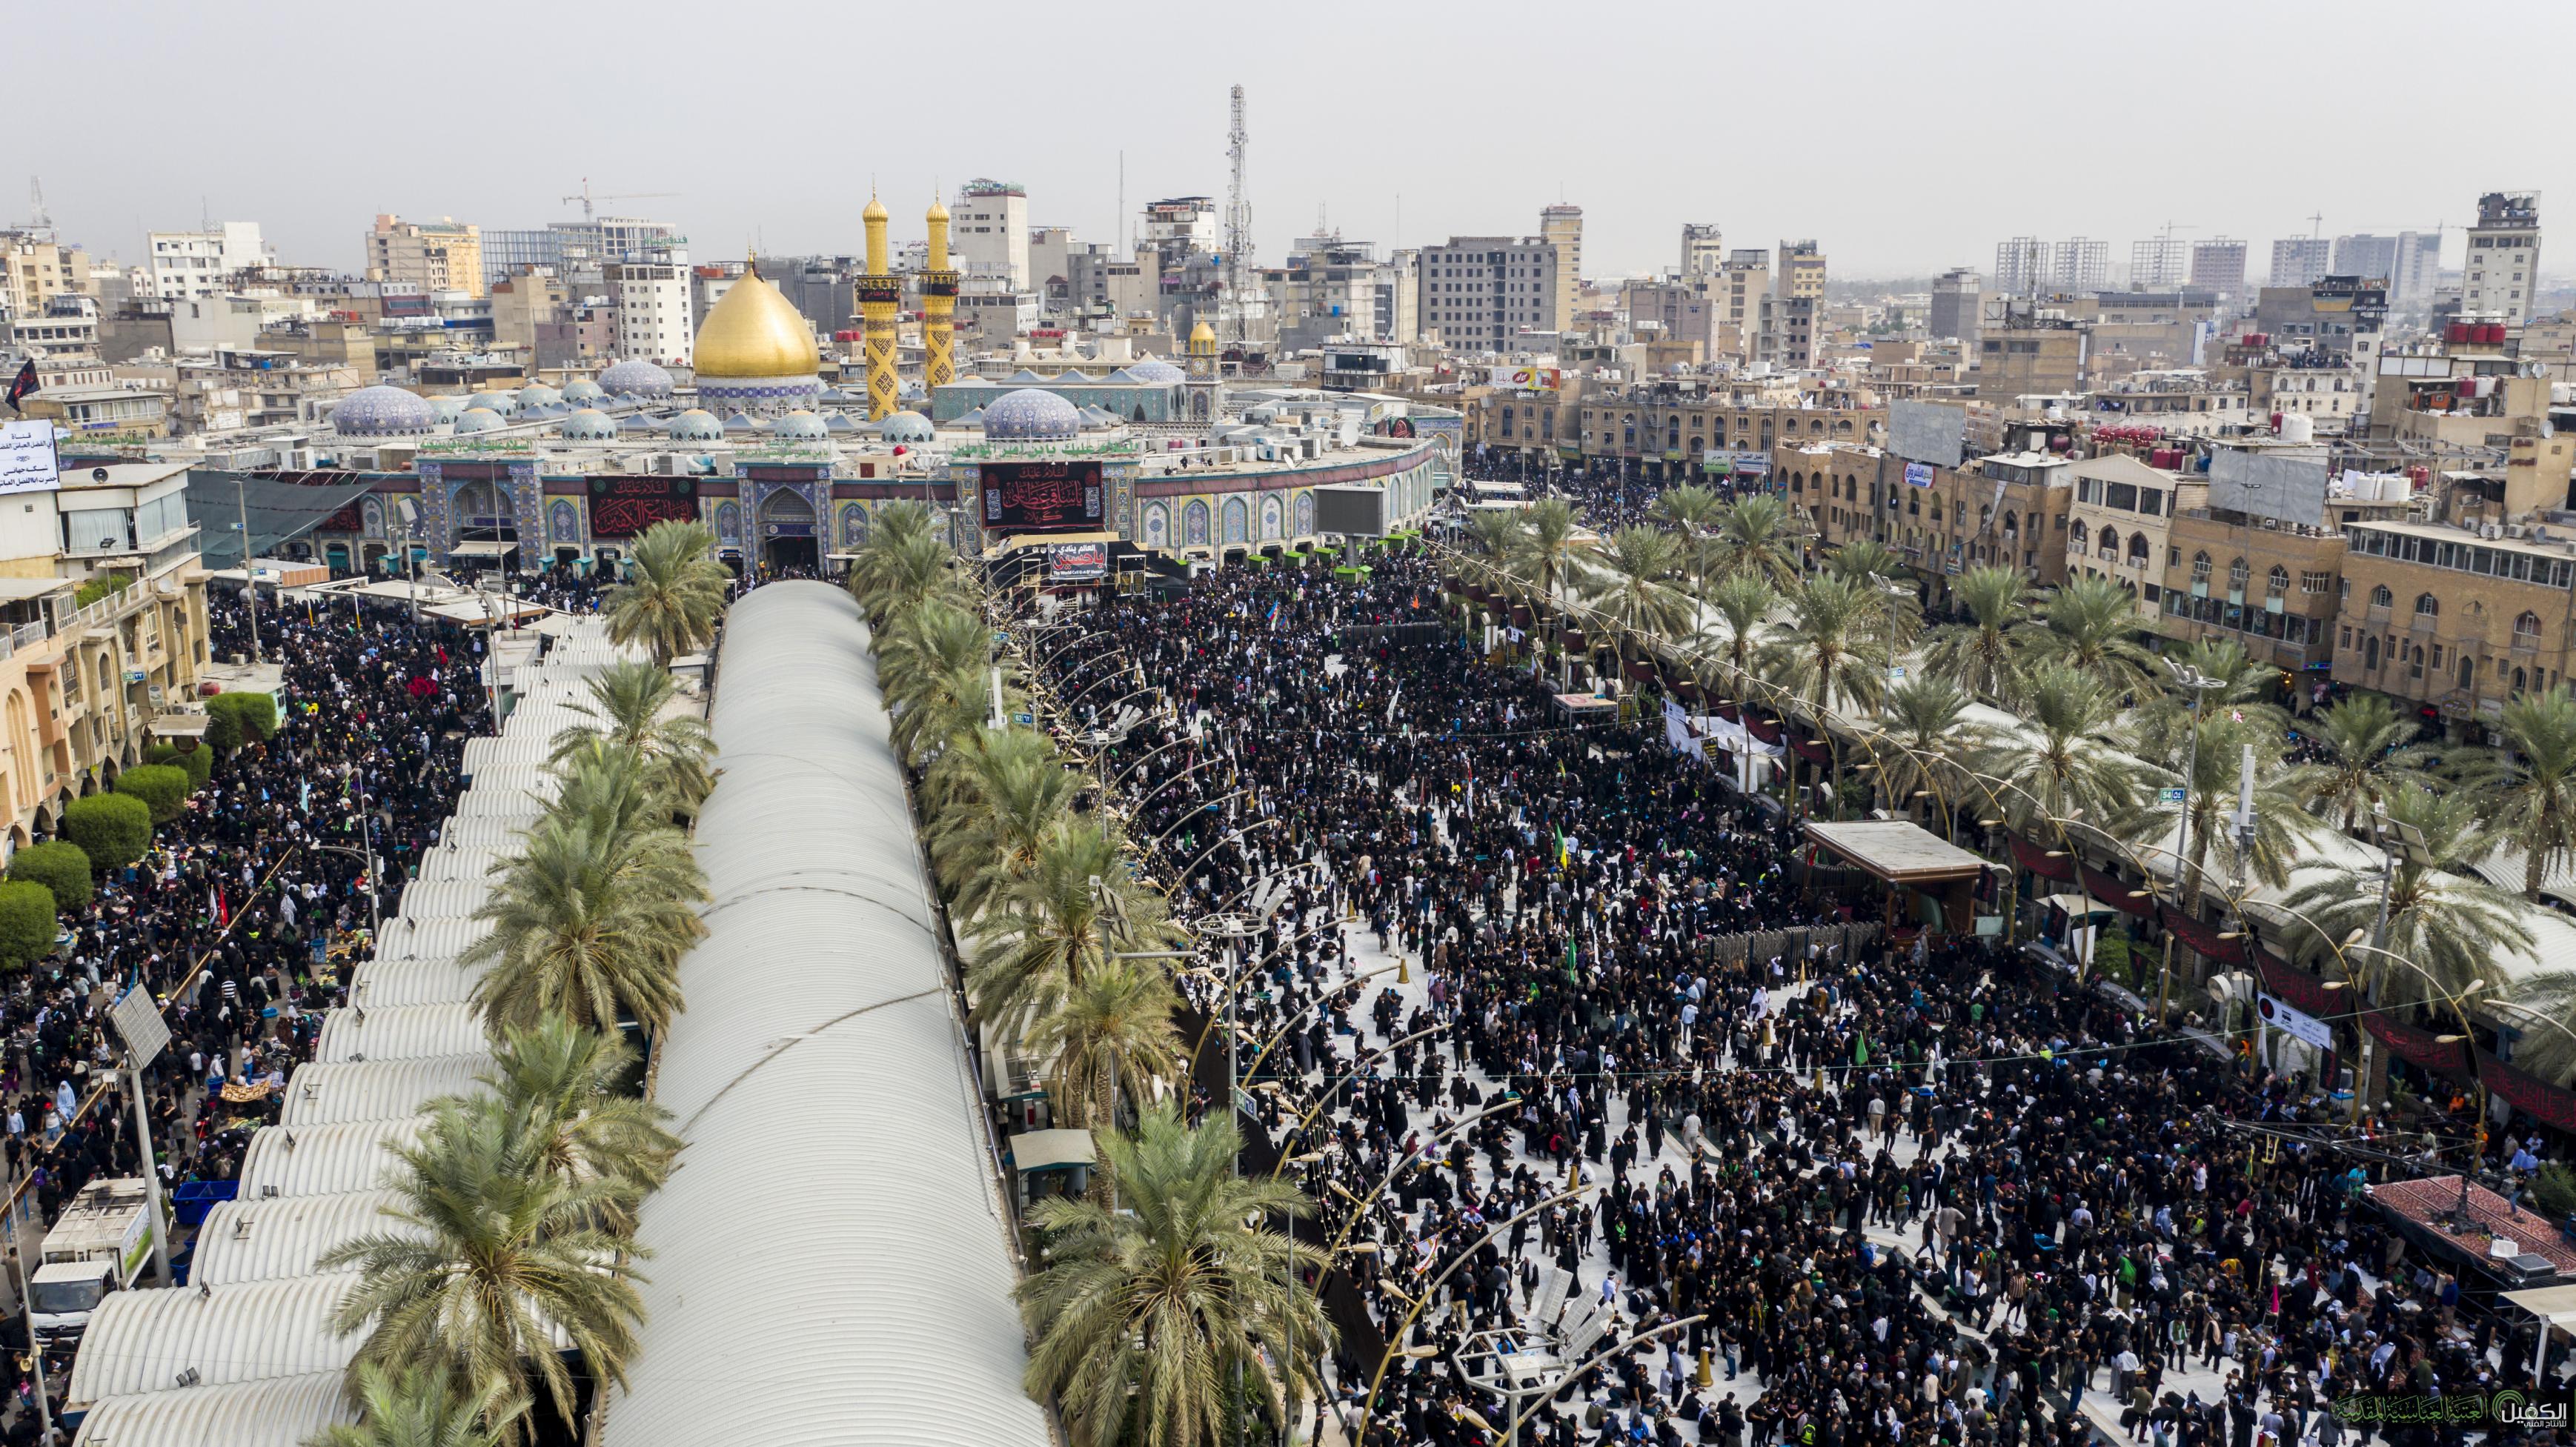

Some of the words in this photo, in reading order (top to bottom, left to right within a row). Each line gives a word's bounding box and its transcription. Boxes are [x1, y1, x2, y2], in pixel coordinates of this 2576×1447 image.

[1019, 466, 1041, 479] عليك
[1043, 465, 1068, 478] السلام
[614, 480, 640, 496] عليك
[640, 479, 670, 495] السلام
[1058, 545, 1077, 555] ينادي
[1078, 544, 1095, 554] العالم
